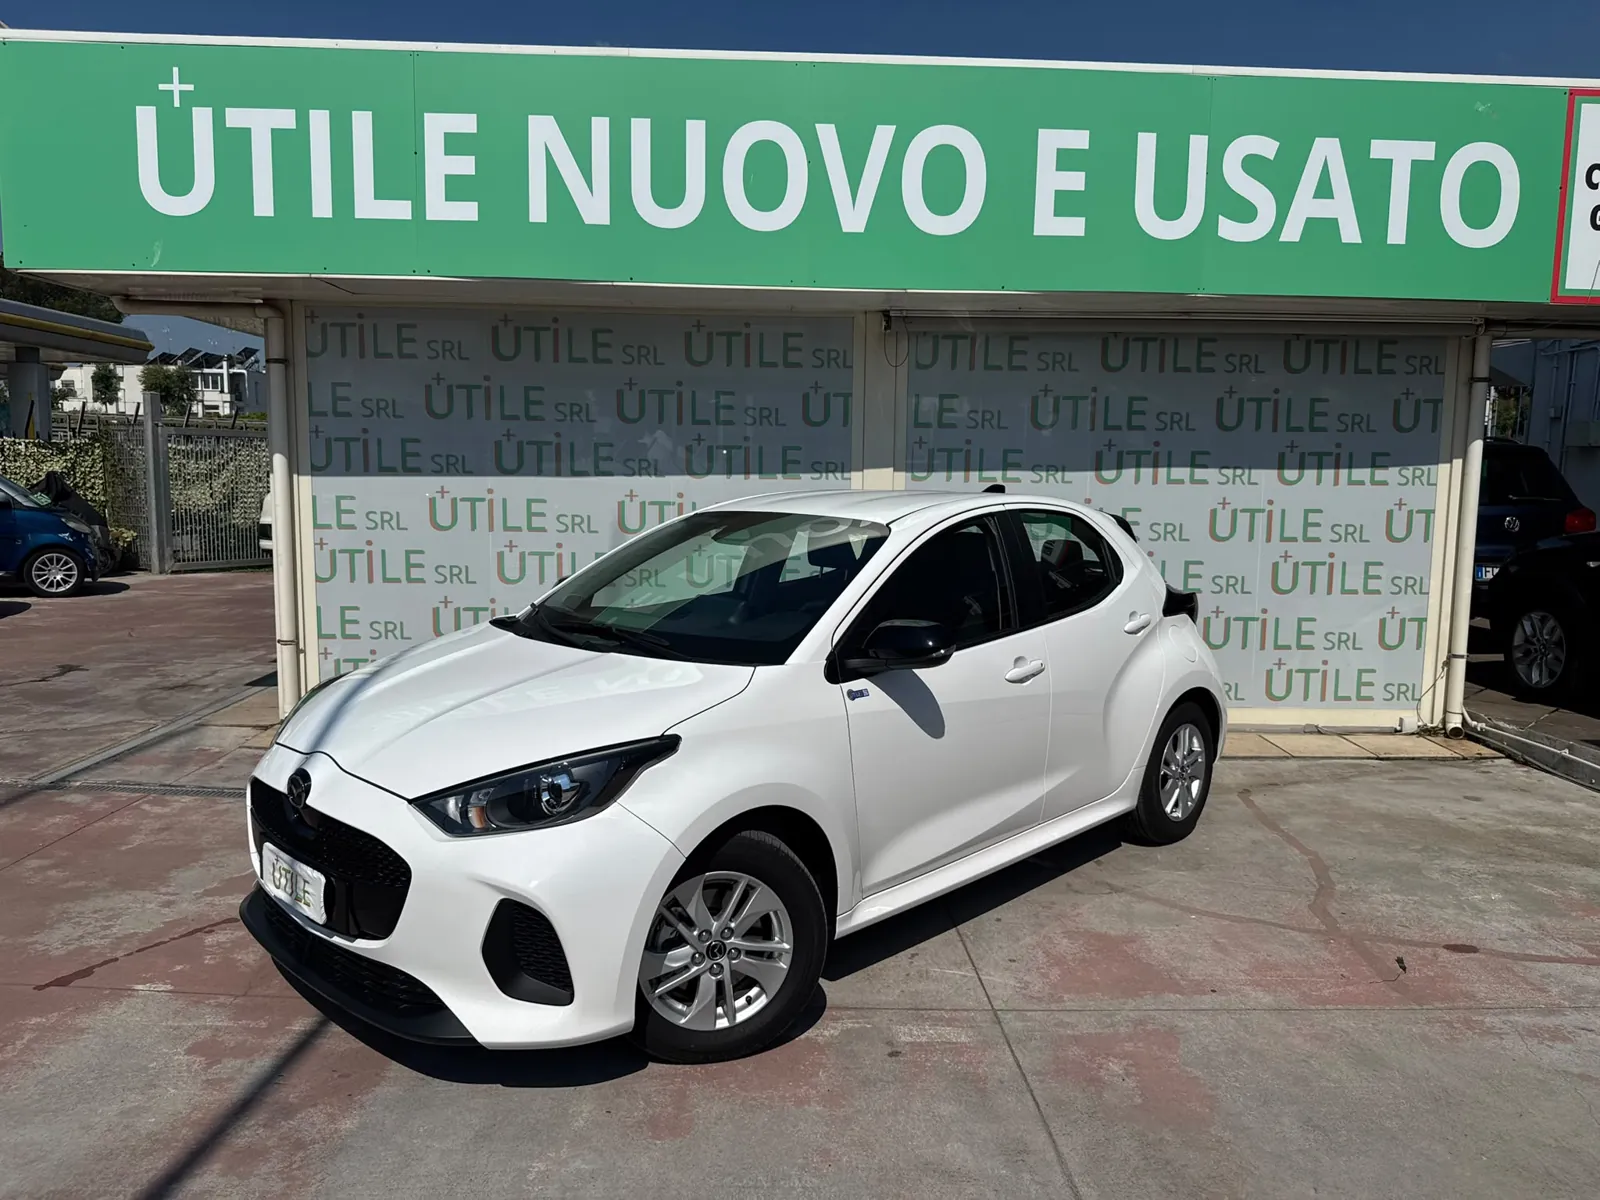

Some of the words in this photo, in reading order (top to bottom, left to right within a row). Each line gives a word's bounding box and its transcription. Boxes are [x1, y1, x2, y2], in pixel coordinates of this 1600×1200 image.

[136, 66, 479, 222] UTILE
[528, 114, 987, 236] NUOVO
[1033, 128, 1090, 236] E
[1134, 131, 1521, 249] USATO
[427, 340, 469, 360] SRL
[622, 345, 665, 366] SRL
[811, 348, 853, 369] SRL
[1037, 351, 1079, 372] SRL
[1223, 353, 1265, 374] SRL
[1404, 354, 1445, 375] SRL
[361, 399, 404, 419] SRL
[554, 402, 597, 423] SRL
[743, 406, 786, 427] SRL
[966, 409, 1008, 430] SRL
[1154, 411, 1196, 432] SRL
[1336, 413, 1377, 433] SRL
[430, 454, 473, 474] SRL
[623, 458, 666, 478] SRL
[810, 461, 852, 480] SRL
[1030, 464, 1073, 484] SRL
[1217, 465, 1259, 486] SRL
[1397, 466, 1437, 487] SRL
[365, 510, 408, 531] SRL
[555, 513, 599, 534] SRL
[1148, 522, 1190, 543] SRL
[1329, 523, 1371, 544] SRL
[434, 564, 477, 585] SRL
[1210, 575, 1252, 595] SRL
[1389, 576, 1429, 596] SRL
[369, 620, 412, 641] SRL
[1322, 631, 1364, 651] SRL
[1382, 683, 1421, 702] SRL
